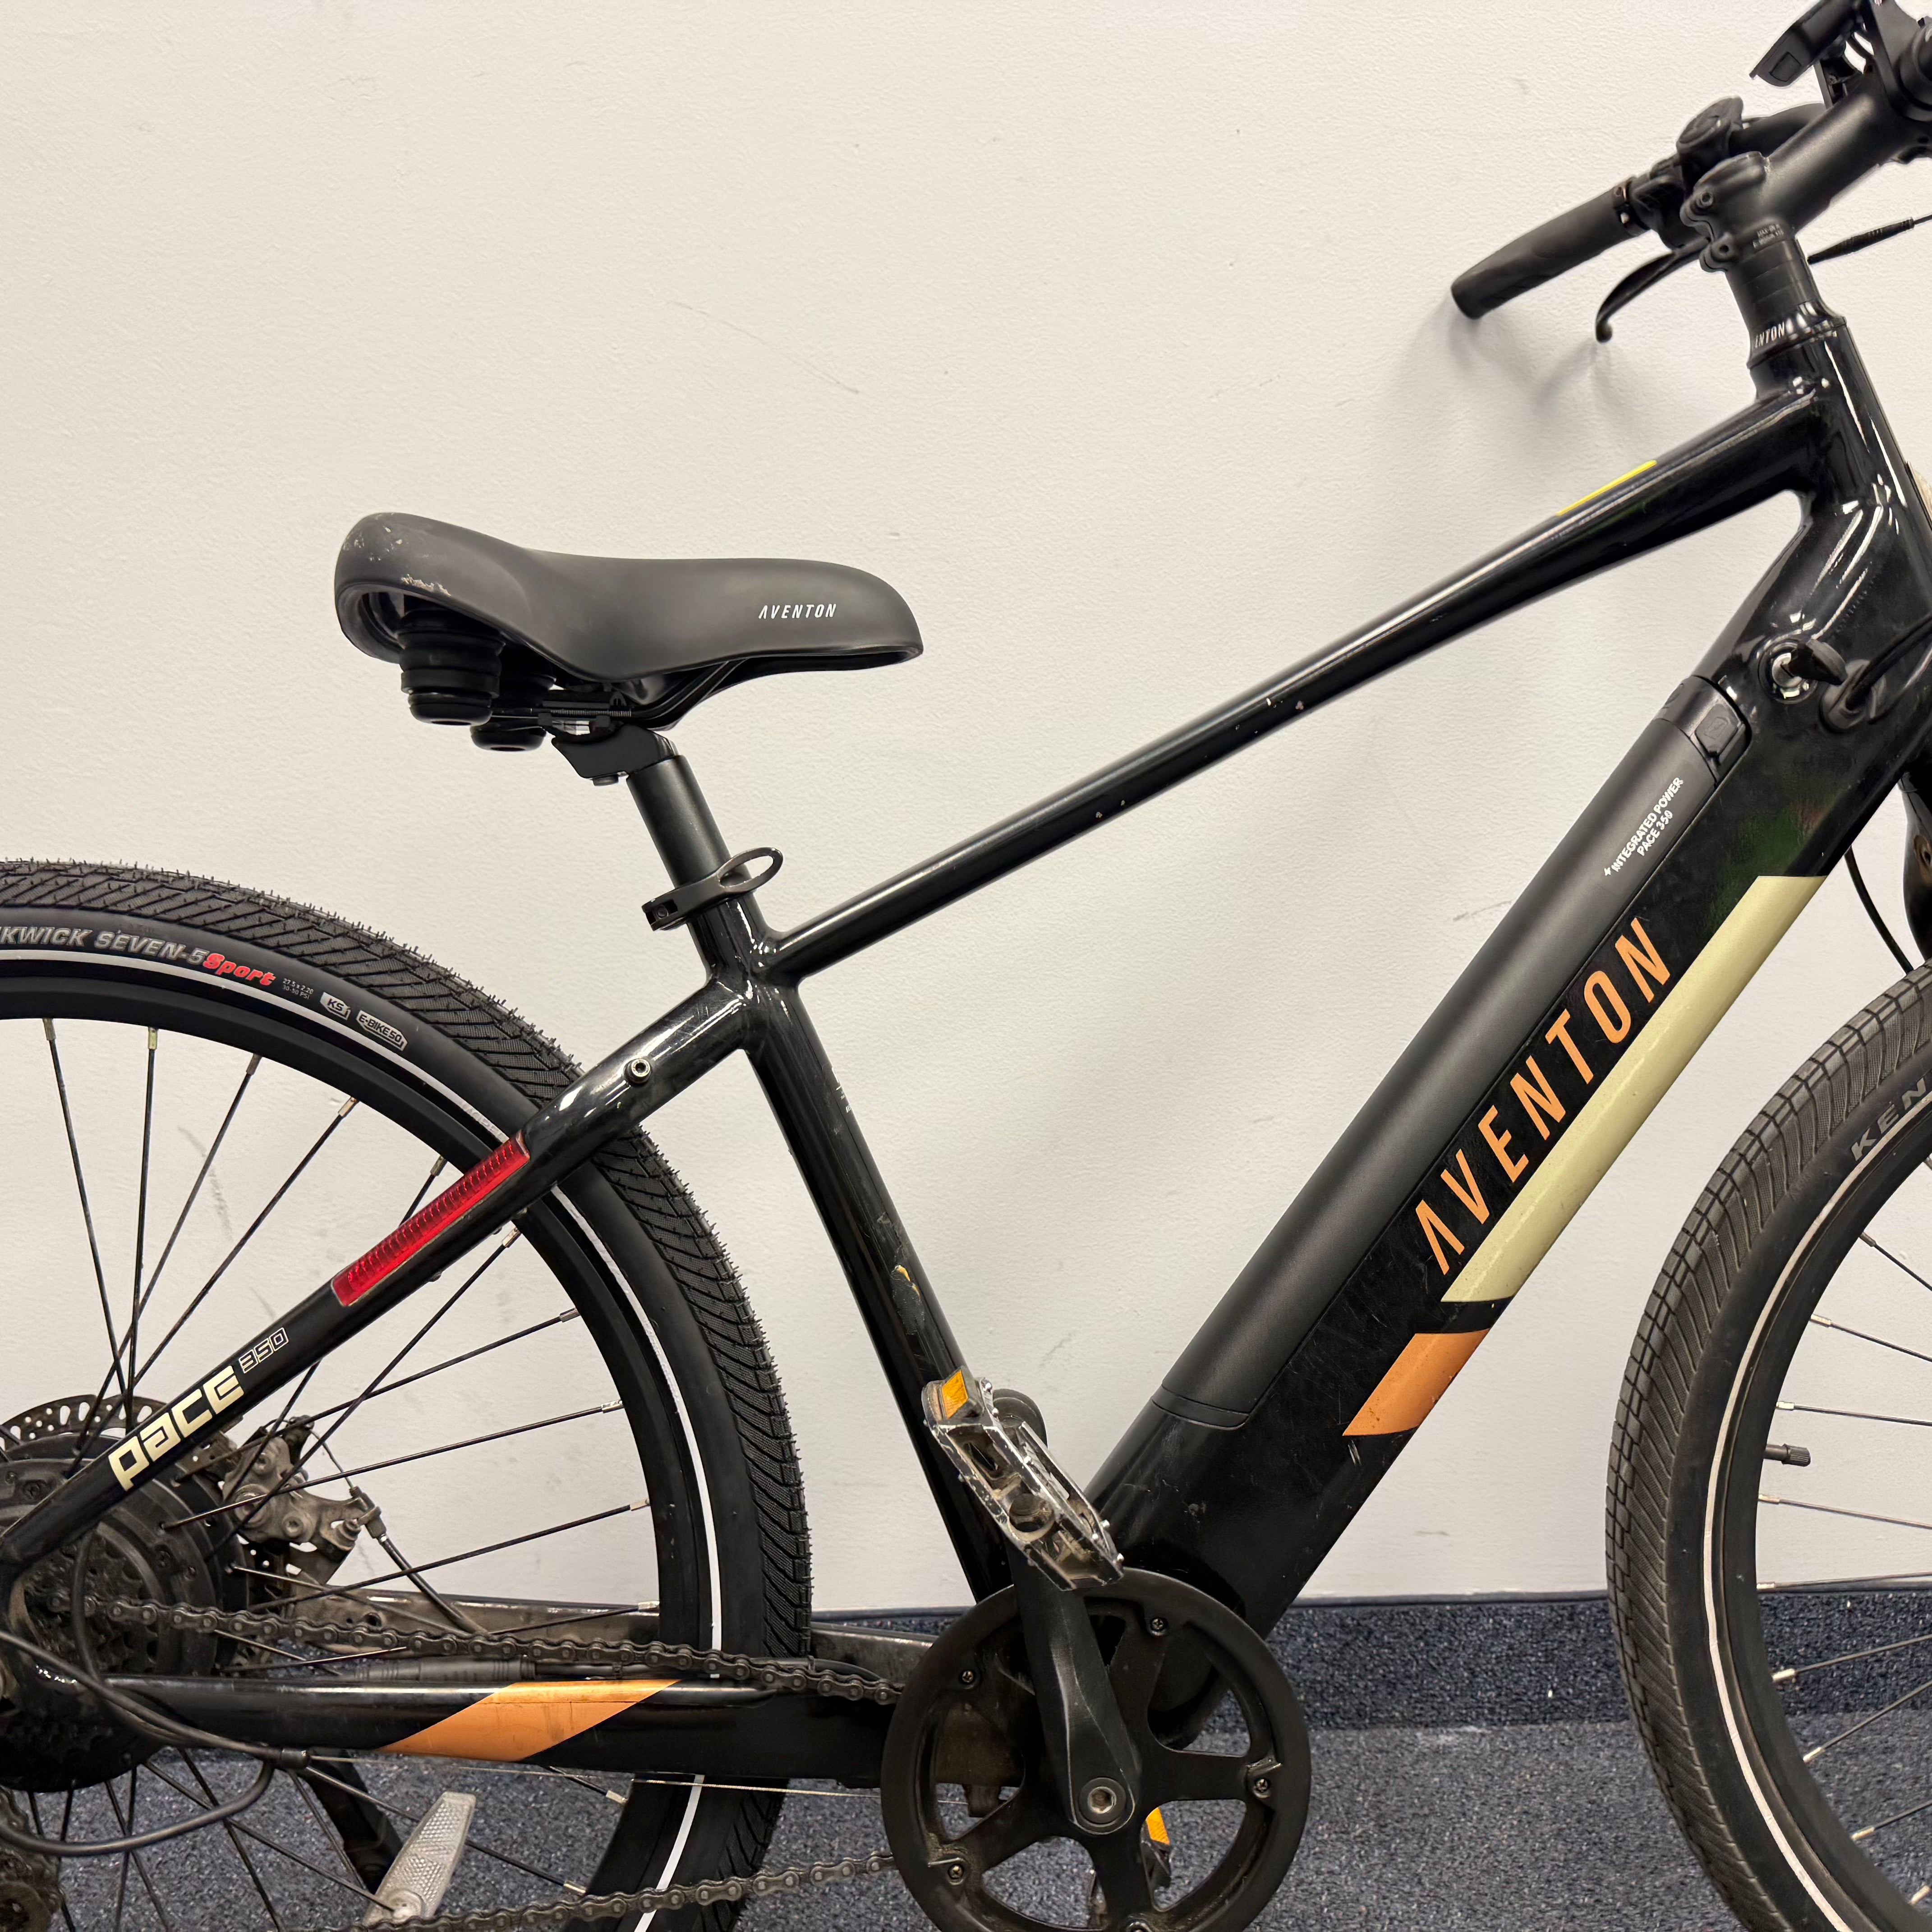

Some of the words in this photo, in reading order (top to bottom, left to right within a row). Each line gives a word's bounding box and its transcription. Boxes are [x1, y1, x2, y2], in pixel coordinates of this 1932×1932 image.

[758, 603, 837, 619] AVENTON
[1611, 812, 1657, 872] INTEGRATED
[1653, 777, 1684, 814] POWER
[1637, 828, 1660, 856] PACE
[1656, 810, 1673, 830] 350
[0, 926, 93, 947] KWICK
[202, 953, 276, 986] Sport
[1415, 917, 1670, 1275] AVENTON
[238, 1327, 289, 1374] 350
